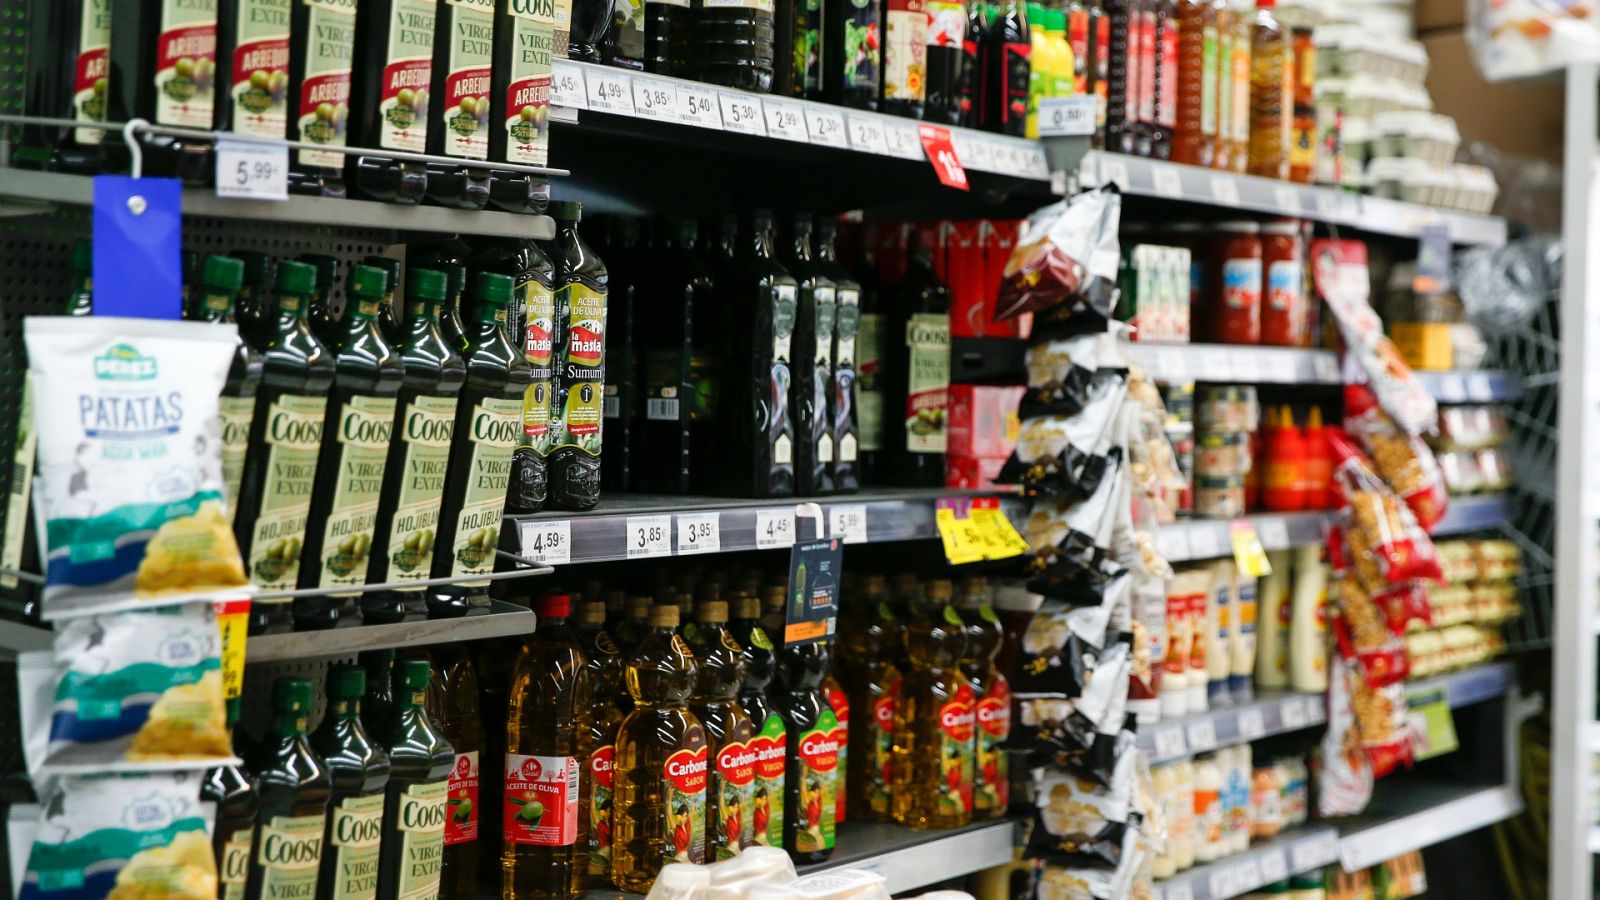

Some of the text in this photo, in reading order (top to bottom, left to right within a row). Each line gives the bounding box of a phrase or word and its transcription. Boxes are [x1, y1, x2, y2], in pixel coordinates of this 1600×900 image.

[573, 306, 583, 315] DE
[527, 329, 534, 339] la
[571, 331, 579, 341] la
[567, 365, 602, 379] Sumum
[79, 391, 184, 427] PATATAS
[533, 531, 565, 554] 4,59€
[528, 783, 538, 791] DE
[538, 784, 560, 794] OLIVA
